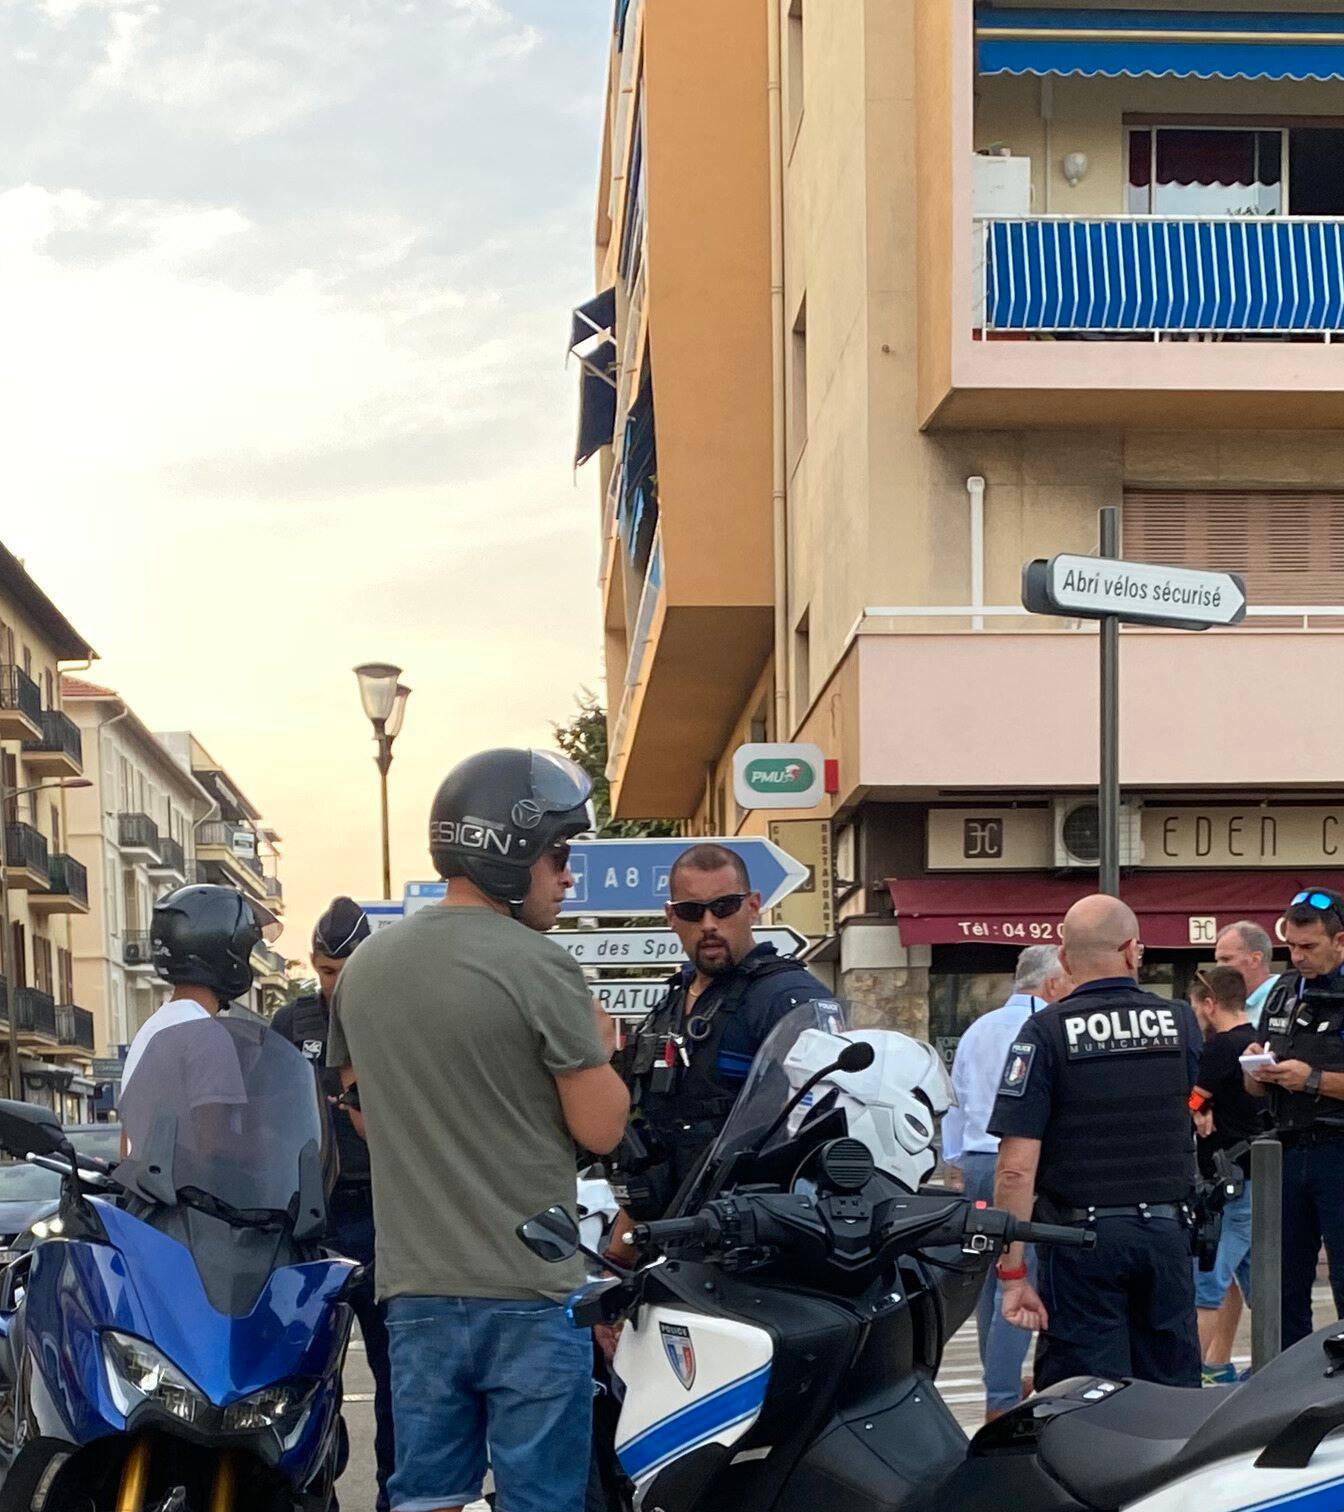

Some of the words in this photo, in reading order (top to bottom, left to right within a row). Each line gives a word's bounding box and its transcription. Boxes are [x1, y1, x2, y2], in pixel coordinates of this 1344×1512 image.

[1062, 569, 1100, 593] Abri
[1104, 575, 1148, 600] vélos
[1152, 581, 1222, 608] sécurisé
[751, 771, 784, 783] PMU
[431, 820, 512, 855] ESIGN
[1163, 815, 1277, 857] EDEN
[1002, 922, 1025, 938] 04
[1029, 922, 1053, 939] 92
[597, 941, 629, 956] des
[1065, 1009, 1178, 1044] POLICE
[1069, 1036, 1180, 1053] MUNICIPALE
[661, 1324, 688, 1337] POLICE
